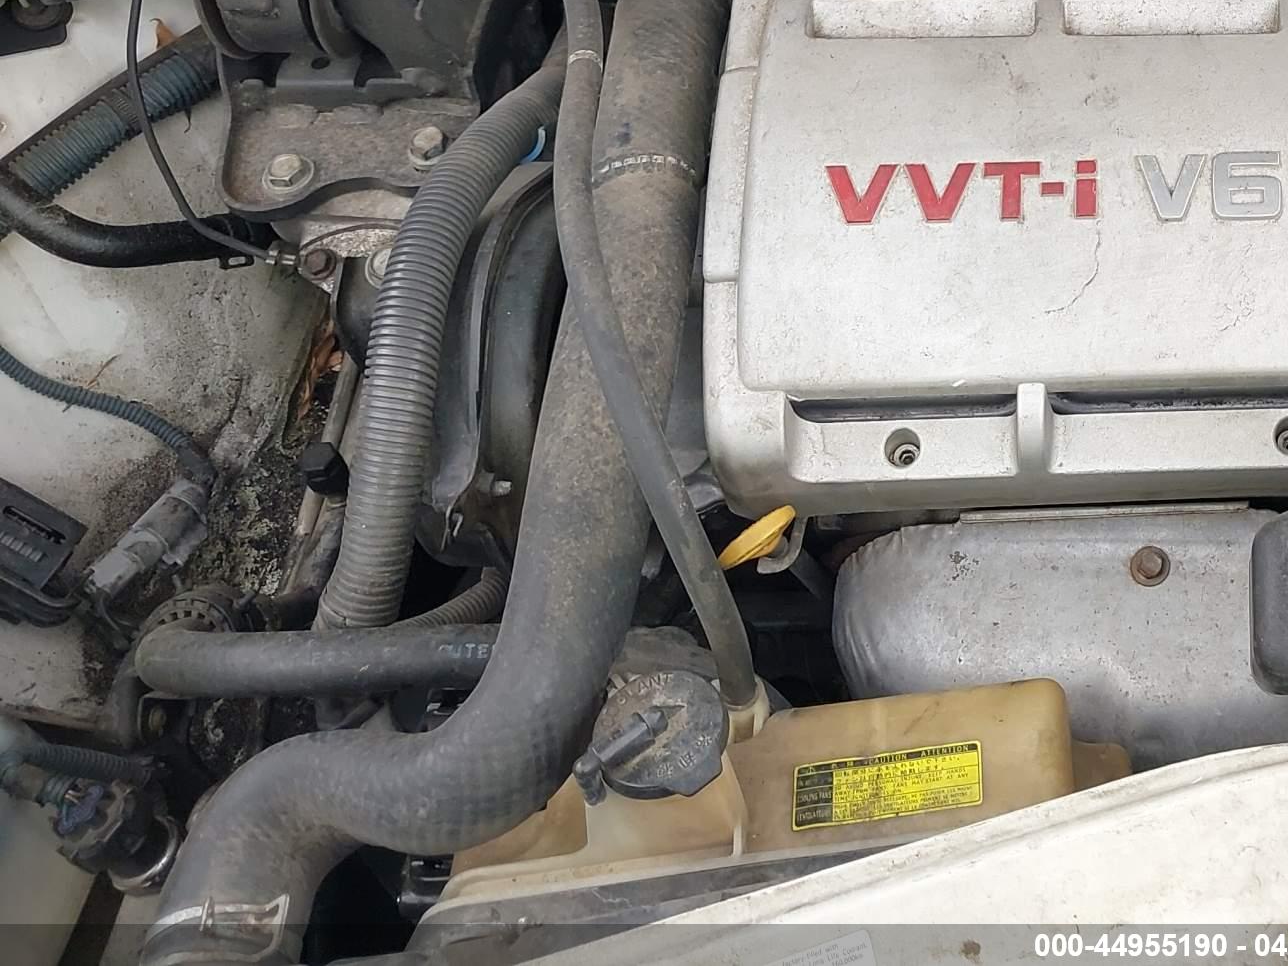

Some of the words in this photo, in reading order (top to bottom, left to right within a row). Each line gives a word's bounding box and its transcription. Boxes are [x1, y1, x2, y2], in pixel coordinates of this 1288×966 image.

[825, 159, 1100, 224] VVT-i
[1134, 150, 1284, 223] V6
[868, 754, 908, 766] CAUTION
[921, 744, 969, 758] ATTENTION
